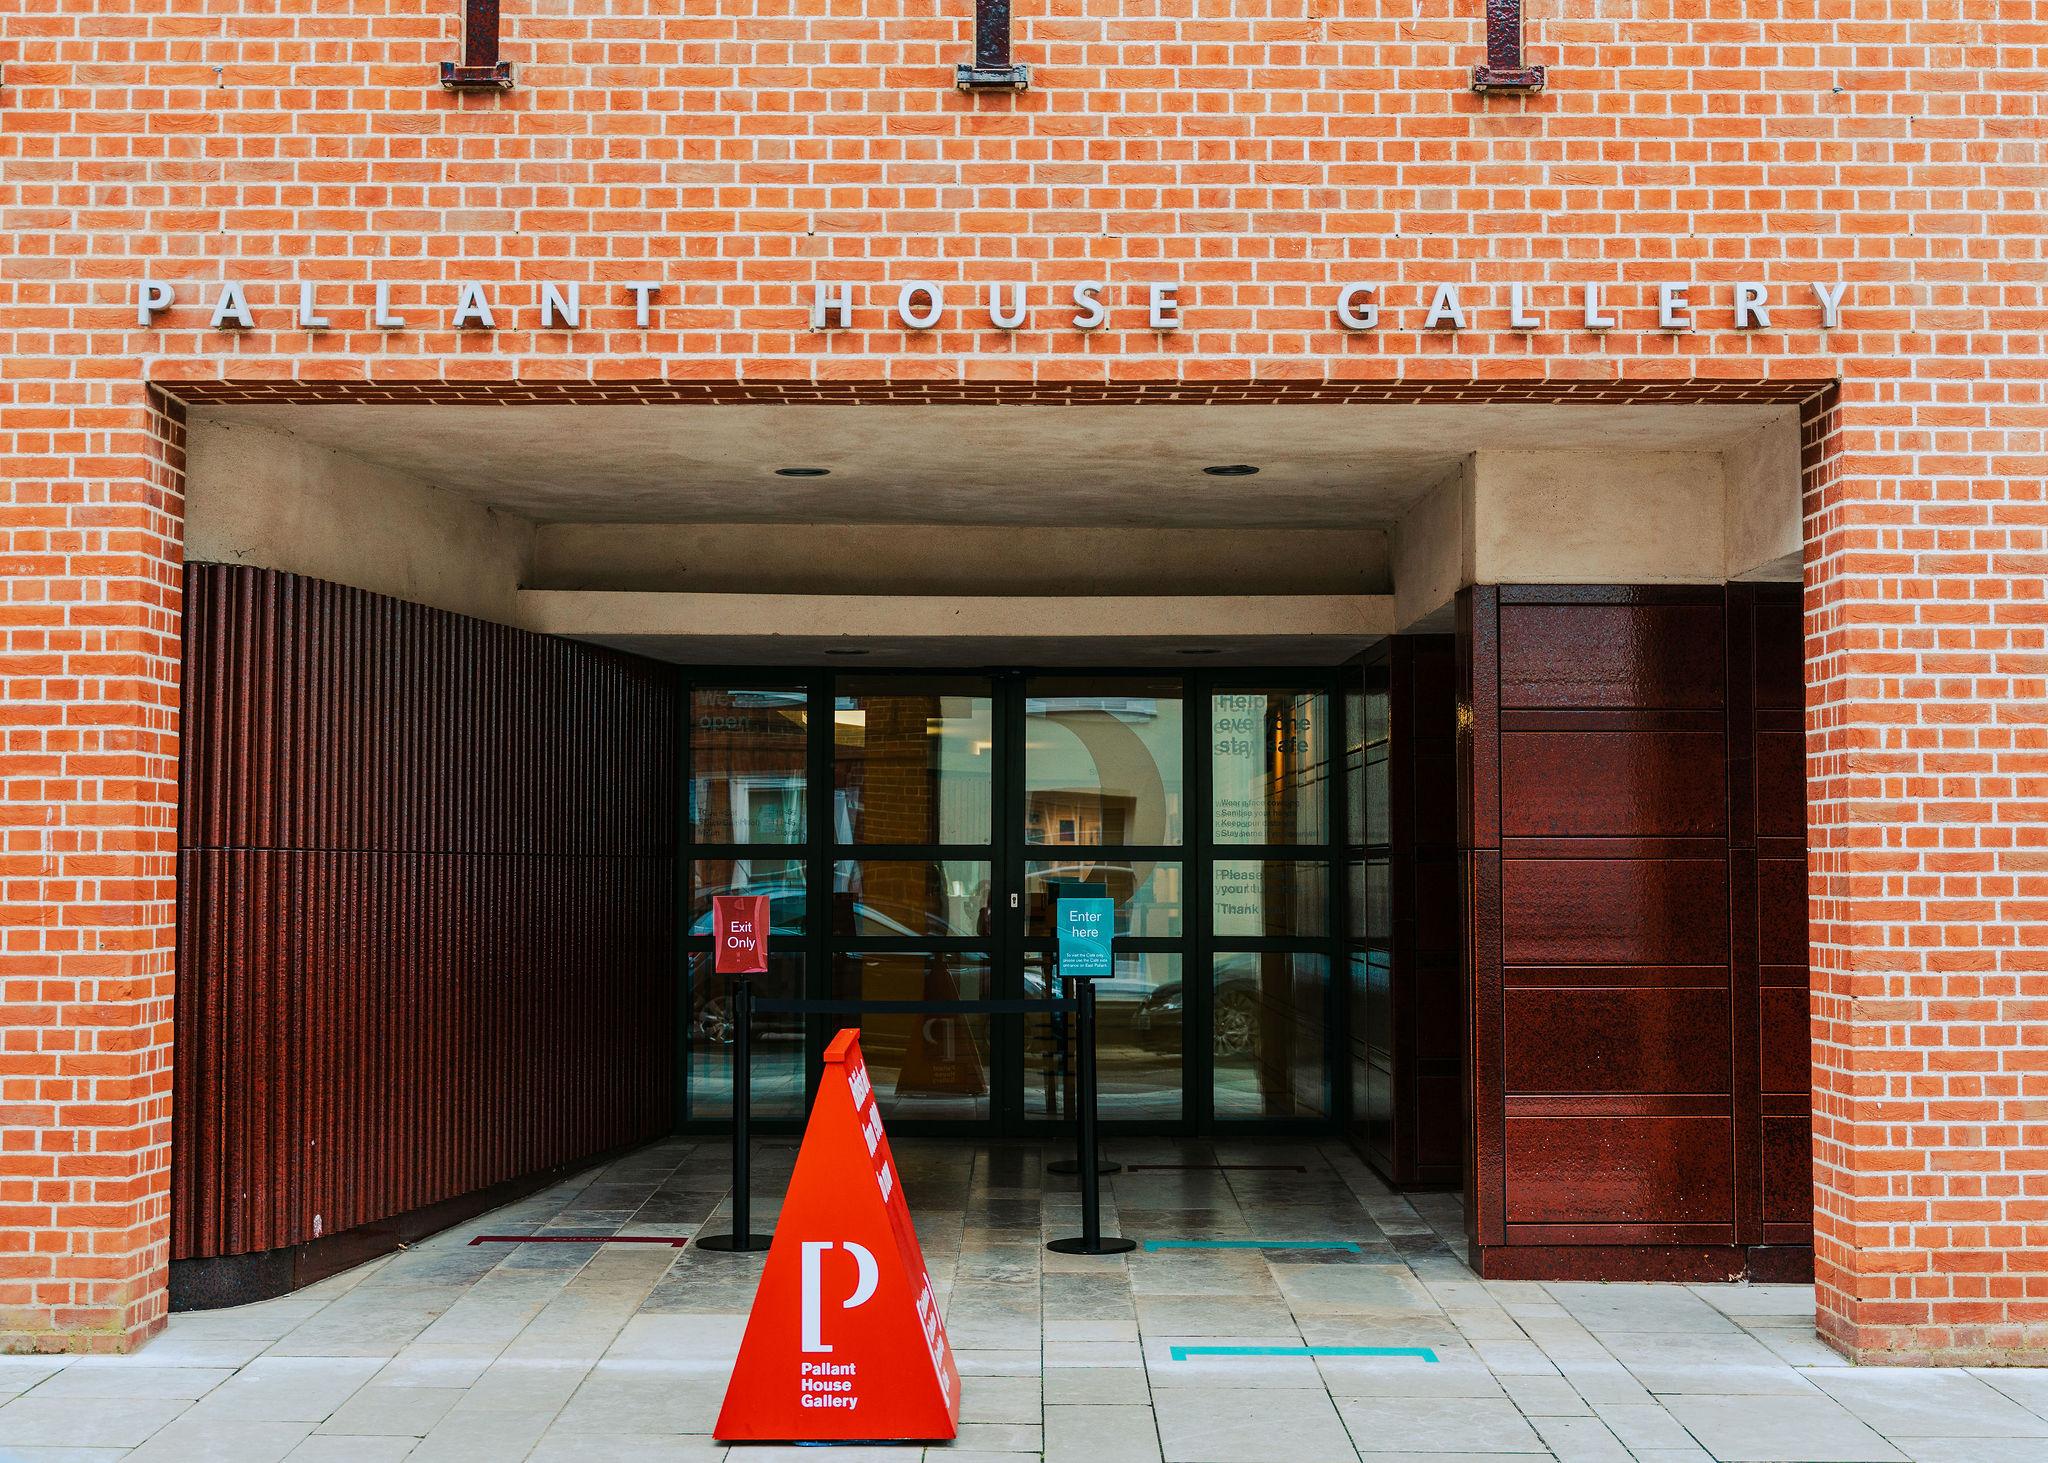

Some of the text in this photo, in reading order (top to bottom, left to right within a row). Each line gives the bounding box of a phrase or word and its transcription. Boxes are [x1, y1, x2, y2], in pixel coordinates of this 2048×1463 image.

[137, 279, 1848, 330] PALLANT HOUSE GALLERY
[1219, 694, 1266, 712] Help
[700, 716, 750, 731] open
[1219, 718, 1311, 735] eveone
[1221, 869, 1263, 880] Please
[1069, 910, 1102, 922] Enter
[1221, 904, 1259, 914] Thank
[730, 921, 752, 933] Exit
[1072, 926, 1099, 938] here
[727, 936, 756, 951] Only
[801, 1362, 856, 1376] Pallant
[801, 1379, 852, 1392] House
[801, 1394, 858, 1410] Gallery
